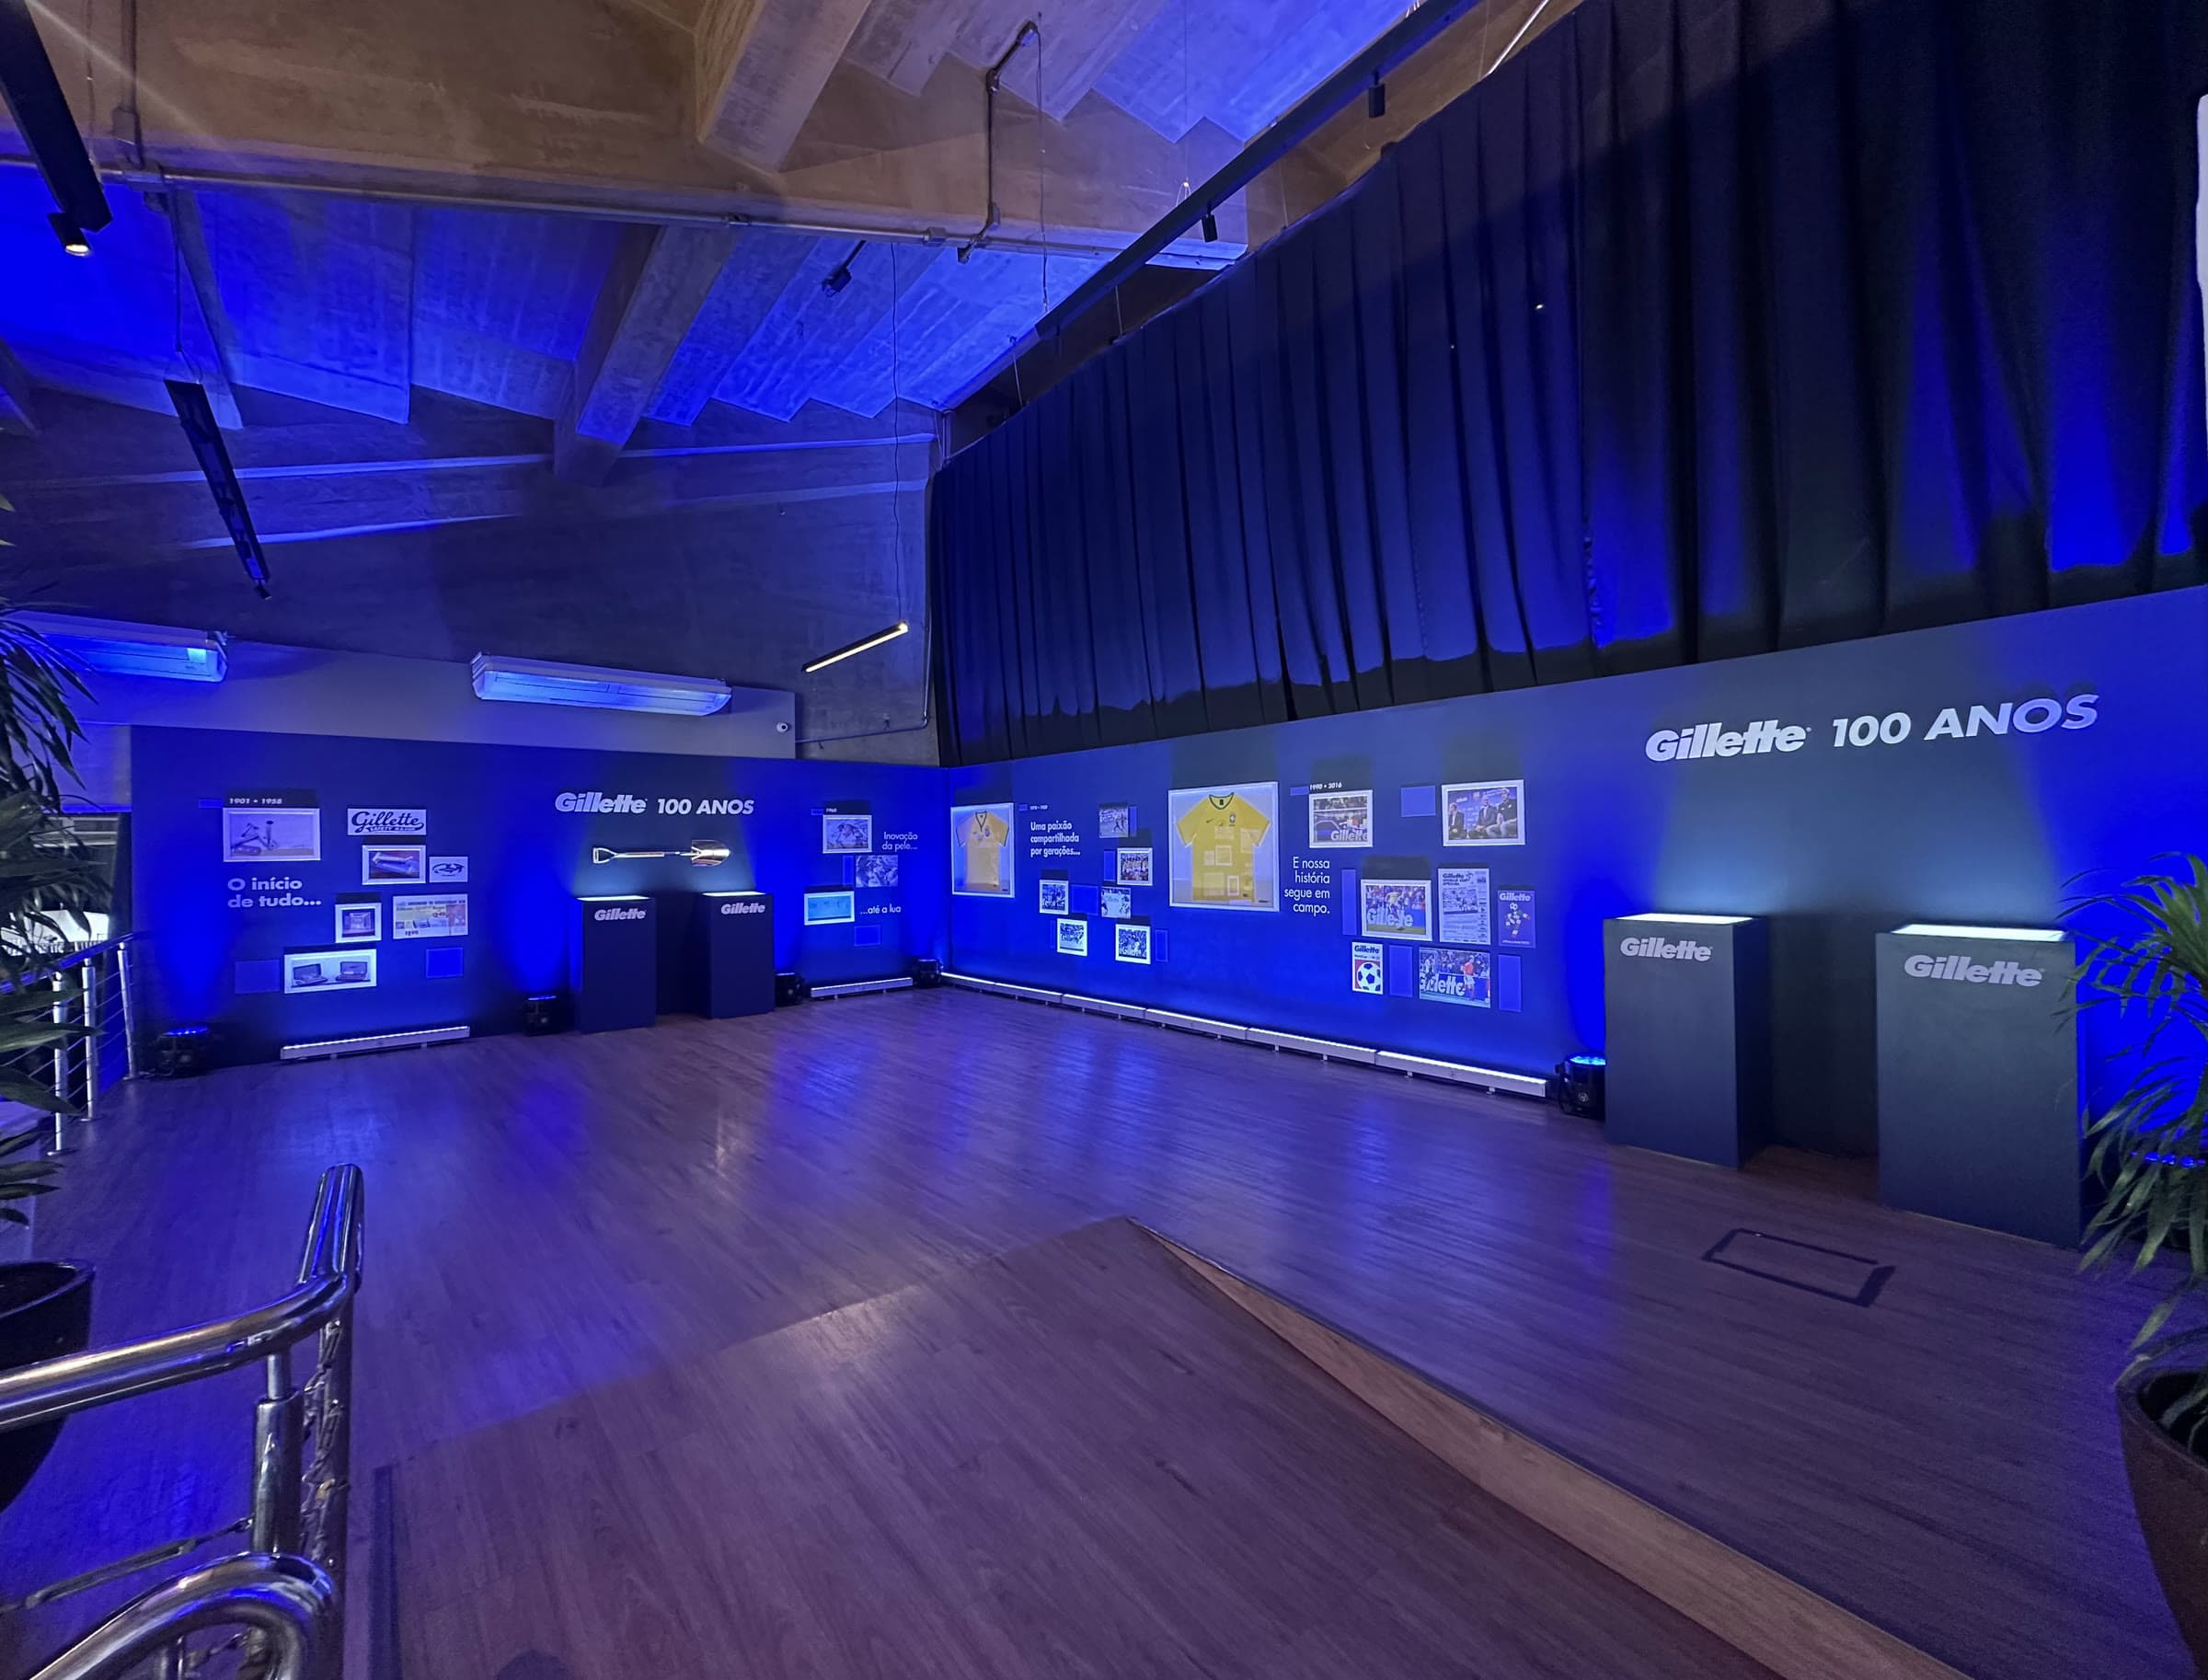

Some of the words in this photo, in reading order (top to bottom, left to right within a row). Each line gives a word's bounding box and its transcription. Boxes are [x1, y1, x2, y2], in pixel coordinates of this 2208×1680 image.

[1645, 718, 1808, 764] Gillette
[1833, 712, 1912, 748] 100
[1924, 693, 2099, 742] ANOS
[555, 791, 645, 815] Gillette
[657, 798, 692, 815] 100
[696, 798, 754, 816] ANOS
[351, 811, 424, 834] Gillette
[1030, 821, 1046, 831] Uma
[1047, 820, 1073, 834] paixão
[883, 831, 918, 841] Inovação
[1030, 832, 1079, 846] compartilhada
[881, 840, 893, 850] da
[1030, 847, 1041, 857] por
[1043, 846, 1081, 857] gerações...
[1293, 857, 1299, 869] E
[1302, 859, 1330, 869] nossa
[1294, 870, 1330, 884] história
[227, 878, 246, 892] O
[251, 877, 303, 892] início
[227, 894, 254, 908] de
[259, 893, 322, 907] tudo...
[1284, 889, 1313, 902] segue
[1315, 890, 1330, 900] em
[1499, 892, 1531, 902] Gillette
[594, 906, 646, 921] Gillette
[720, 902, 765, 915] Gillette
[889, 903, 902, 914] lua
[1293, 903, 1330, 917] campo.
[1354, 945, 1380, 954] Gillette
[1619, 937, 1712, 962] Gillette
[1903, 954, 2041, 988] Gillette
